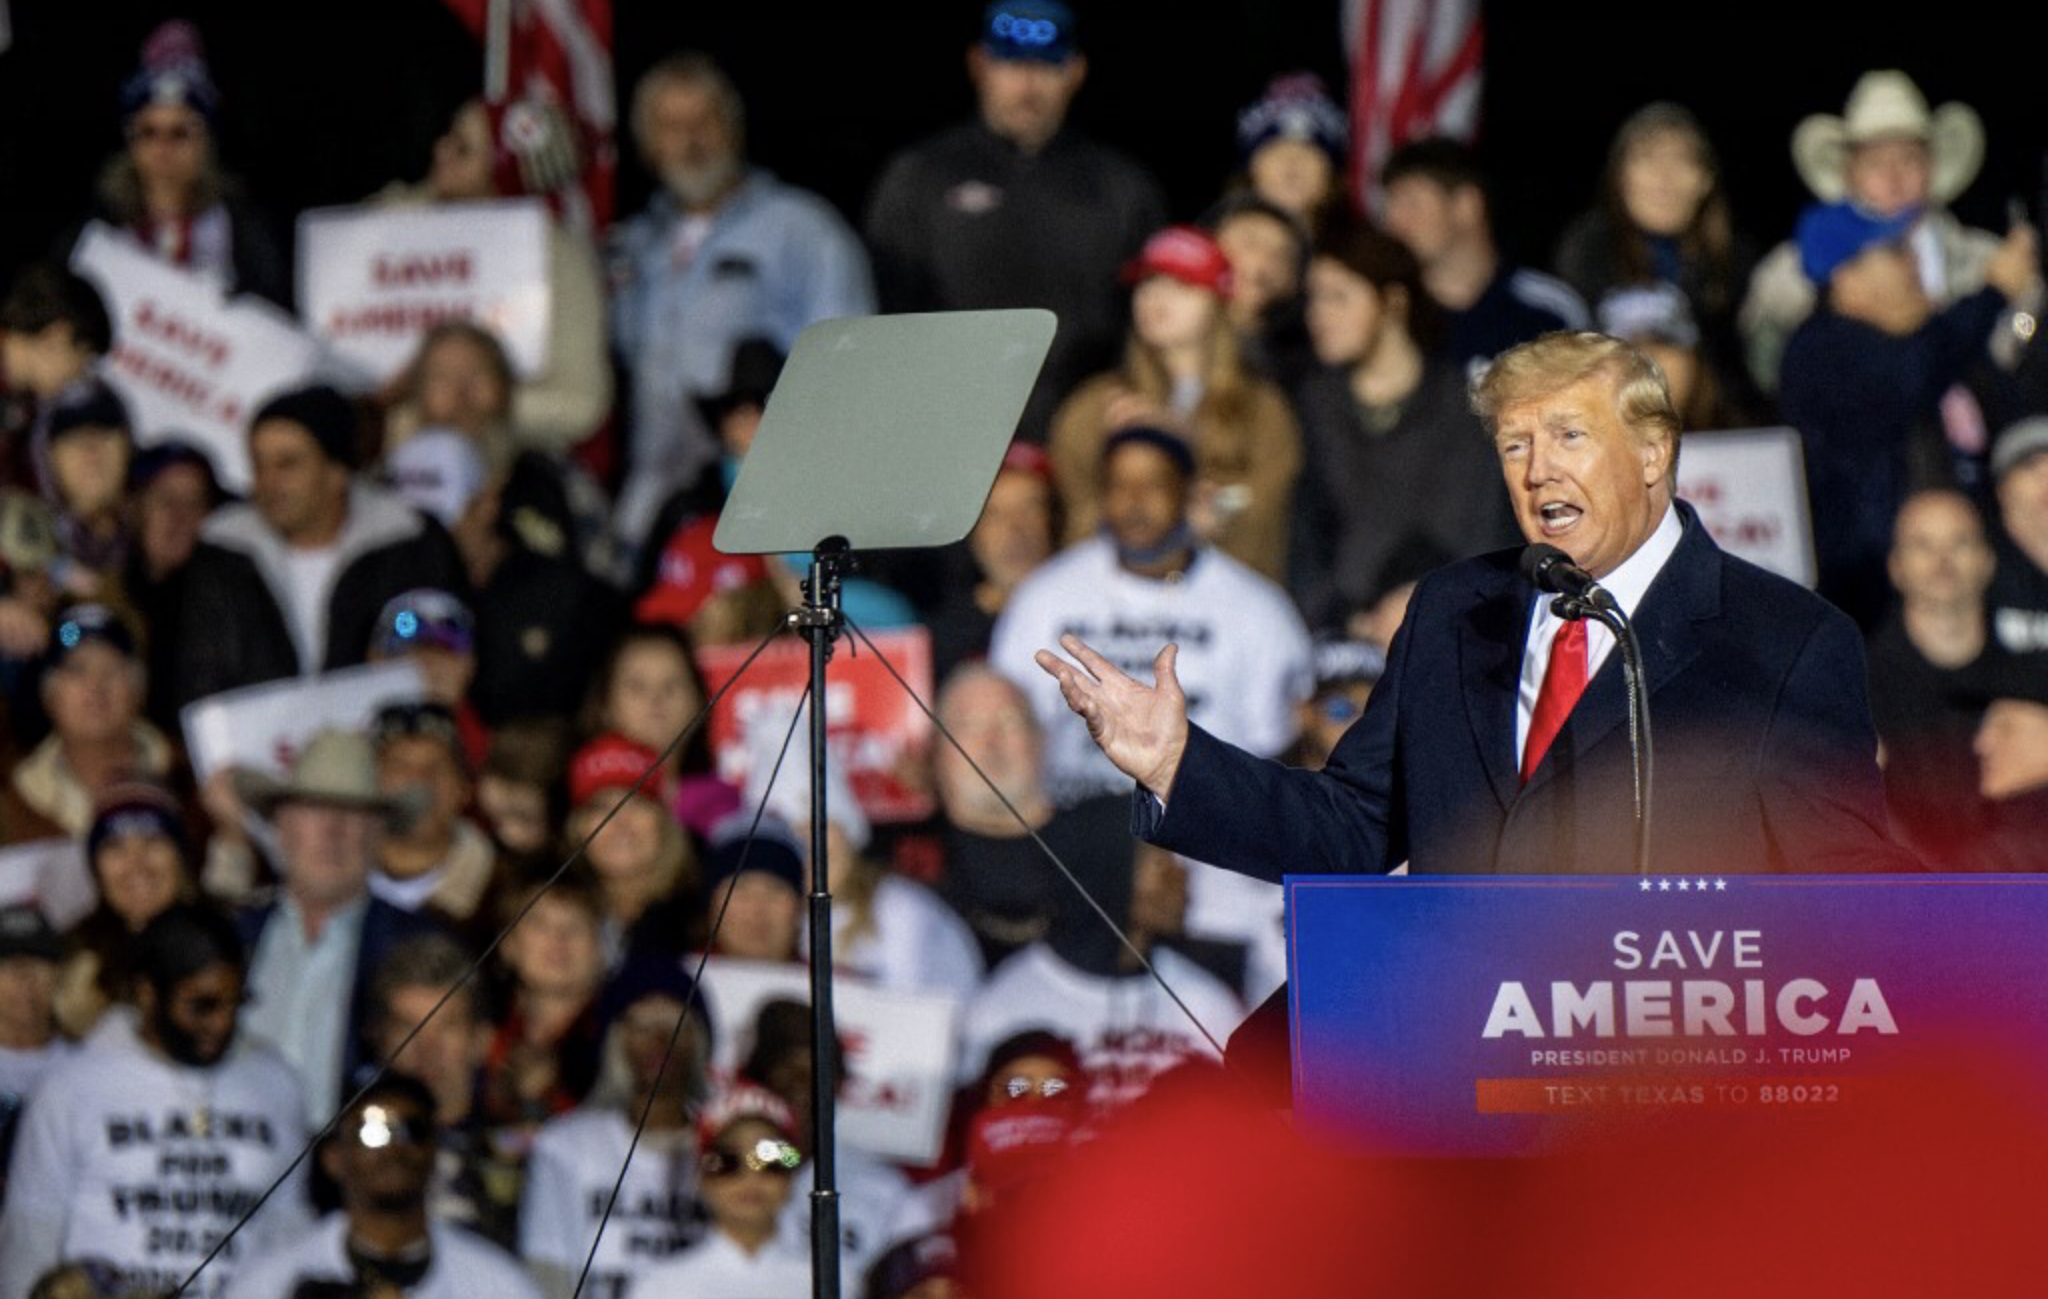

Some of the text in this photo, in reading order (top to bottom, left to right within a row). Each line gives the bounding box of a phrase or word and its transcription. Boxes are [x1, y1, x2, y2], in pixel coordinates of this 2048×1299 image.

[1612, 929, 1763, 970] SAVE
[1481, 978, 1899, 1038] AMERICA
[1530, 1048, 1852, 1066] PRESIDENT DONALD J. TRUMP
[1544, 1084, 1840, 1105] TEXT TEXAS TO 88022
